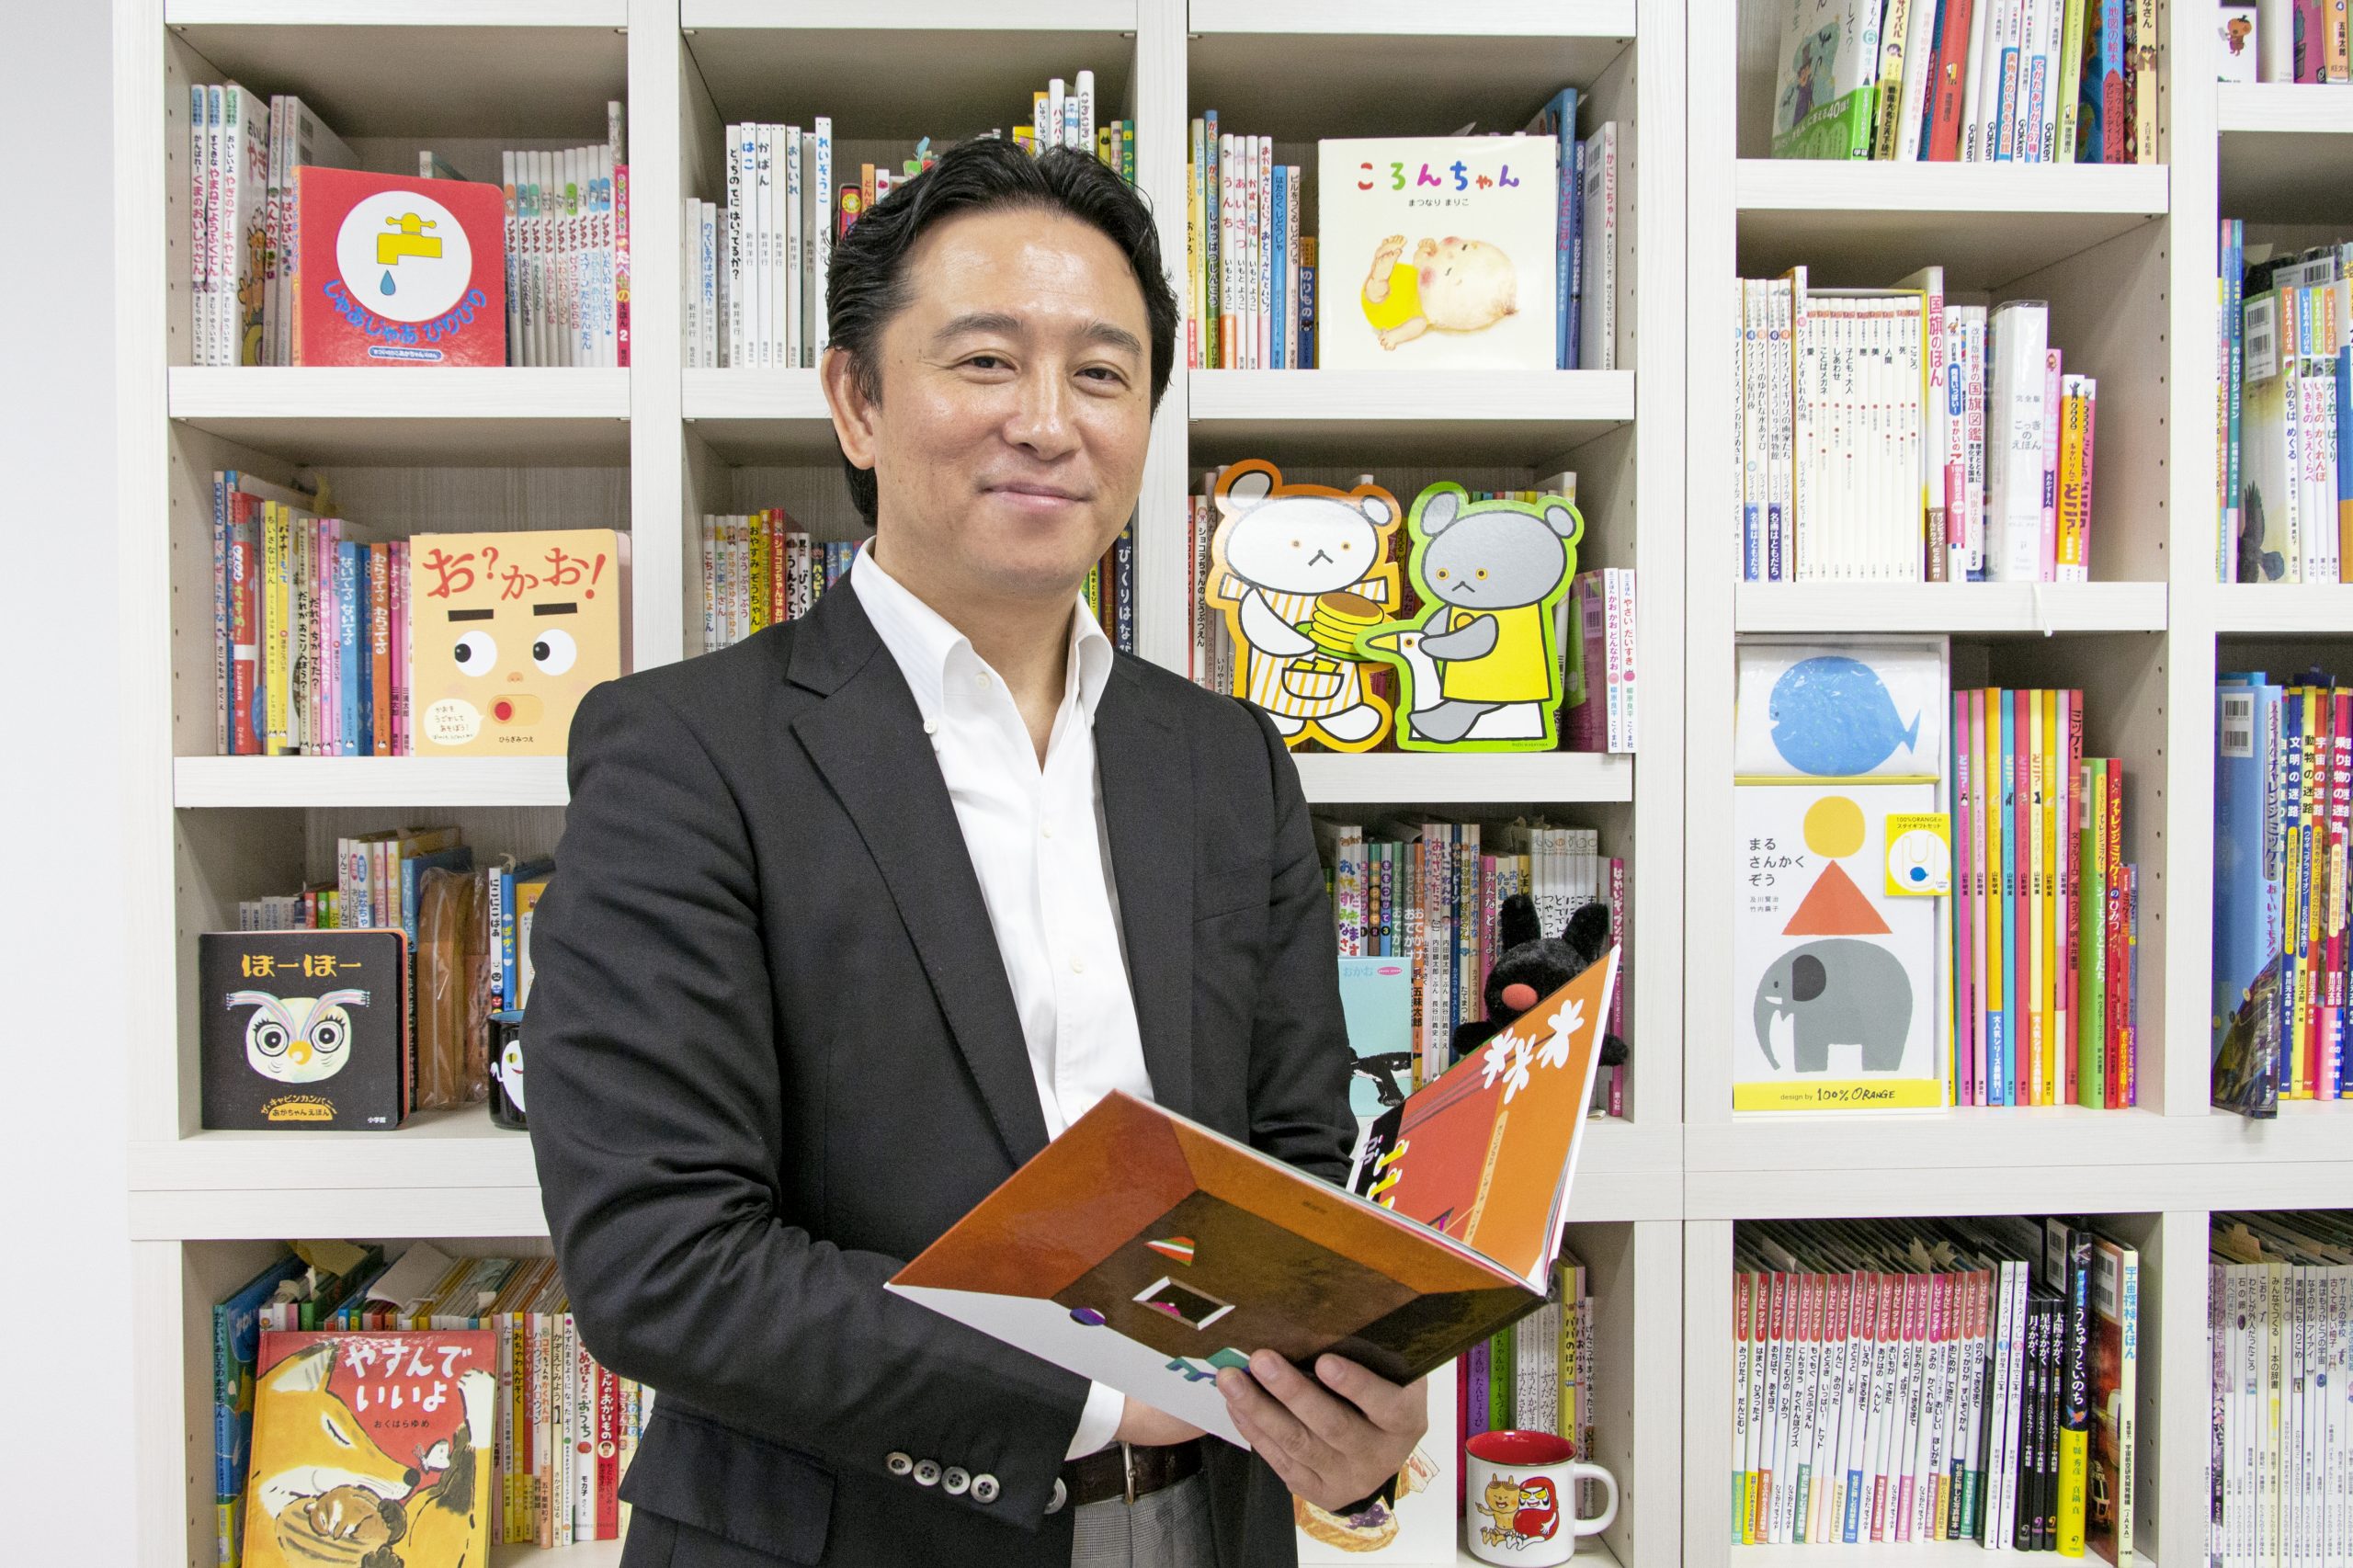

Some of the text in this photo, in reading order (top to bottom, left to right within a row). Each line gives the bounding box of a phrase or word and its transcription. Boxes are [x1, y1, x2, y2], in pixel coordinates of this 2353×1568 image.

[742, 142, 755, 171] はこ
[1966, 123, 1977, 163] Gakken
[1985, 121, 1995, 162] Gakken
[2016, 119, 2027, 159] Gakken
[2042, 121, 2054, 162] Gakken
[757, 142, 770, 187] かばん
[788, 145, 799, 195] おしいれ
[818, 137, 829, 204] れいぞうこ
[1358, 161, 1520, 191] ころんちゃん
[730, 148, 742, 279] どっちの てに はいってるか?
[1222, 176, 1233, 229] うんち
[1235, 177, 1246, 249] あいさつ
[1408, 198, 1470, 208] まつなり まりこ
[192, 175, 203, 276] くまのおいしゃさん
[223, 175, 236, 276] やぎのケーキやさん
[324, 279, 486, 344] じゃあじゃあ びりびり
[1302, 270, 1313, 317] のりもの
[1910, 346, 1918, 371] こころ
[1928, 295, 1944, 388] 国旗のほん
[1796, 328, 1807, 421] ケイティとすいれんの池
[1819, 347, 1828, 395] ことばメガネ
[1832, 347, 1842, 381] しあわせ
[1845, 347, 1854, 395] 子ども・大人
[1781, 342, 1791, 460] ケイティとイギリスの画家たち
[1968, 382, 1982, 442] 国旗図鑑
[2285, 380, 2297, 460] いのちは めぐる
[2326, 381, 2336, 423] かくれて
[1951, 418, 1961, 451] せかいの
[2011, 440, 2041, 451] えほん
[2014, 420, 2042, 431] こっき
[2021, 431, 2032, 440] の
[2302, 381, 2314, 483] いきもの ちえくらべ
[2314, 381, 2325, 483] いきもの かくれんぼ
[1749, 512, 1759, 576] 名画はともだち
[1769, 512, 1779, 576] 名画はともだち
[749, 527, 761, 627] おやすみ ぞうちゃん
[787, 555, 797, 596] うんち
[1623, 598, 1633, 626] やさい
[498, 735, 534, 744] ひらぎみつえ
[2070, 709, 2083, 760] ミッケ!
[2287, 735, 2302, 817] 文明の迷路
[2302, 734, 2315, 814] 動物の迷路
[2313, 735, 2326, 817] 宇宙の迷路
[2331, 736, 2345, 834] 乗り物の迷路
[1749, 837, 1777, 851] まる
[1749, 855, 1805, 869] さんかく
[1484, 872, 1495, 909] みんな
[1748, 873, 1776, 887] ぞう
[1749, 895, 1779, 903] 及川賢治
[241, 954, 361, 978] ほーほー
[2298, 969, 2306, 1003] 香川元太郎
[1413, 986, 1423, 1028] 五味太郎
[1780, 1086, 1896, 1102] design by 100% ORANGE
[2237, 1278, 2246, 1310] 石の卵
[2259, 1276, 2268, 1301] こおり
[2271, 1277, 2279, 1336] みんなでつくる
[2283, 1277, 2291, 1303] おかし
[2338, 1278, 2347, 1338] サーカスの学校
[2123, 1266, 2138, 1360] 宇宙探検えほん
[2248, 1278, 2256, 1371] わたしが外人だったころ
[2306, 1279, 2315, 1358] なぞのサル アイアイ
[2317, 1278, 2326, 1365] 海はもうひとつの宇宙
[1565, 1315, 1575, 1376] パパのぼり
[1576, 1314, 1586, 1374] パパおふろ
[1835, 1347, 1844, 1369] りんご
[1850, 1343, 1859, 1373] さとうと
[2028, 1314, 2039, 1358] 月のかがく
[2040, 1313, 2051, 1366] 星空のかがく
[2052, 1312, 2064, 1366] 太陽のかがく
[2071, 1310, 2087, 1405] うちゅうといのち
[345, 1345, 472, 1379] やすんで
[514, 1334, 523, 1403] おちゃわんかぞく
[552, 1334, 563, 1402] かぞえてみよう
[564, 1328, 574, 1390] みずたまもように
[1527, 1367, 1537, 1395] ふうた
[1586, 1324, 1595, 1424] げんこつやまがあったとさ
[1754, 1346, 1764, 1377] はまべで
[1767, 1346, 1779, 1413] おちばで あそぼう
[1796, 1346, 1806, 1383] こんちゅう
[1884, 1346, 1897, 1405] おいもが できた
[1914, 1346, 1923, 1383] はちみつが
[1928, 1348, 1938, 1370] うみの
[356, 1381, 449, 1413] いいよ
[1474, 1378, 1484, 1427] たんじょうび
[1518, 1368, 1527, 1397] ふうた
[1540, 1369, 1550, 1398] ふうた
[1547, 1368, 1558, 1397] ふうた
[1779, 1346, 1793, 1420] かたつむりの ひみつ
[1859, 1374, 1870, 1412] できるまで
[373, 1418, 430, 1429] おくはらゆめ
[1736, 1397, 1746, 1435] だんごむし
[1934, 1400, 1944, 1430] おいしい
[1959, 1386, 1969, 1432] すいぞくかん
[1816, 1427, 1826, 1449] トマト
[580, 1475, 588, 1496] モカ子
